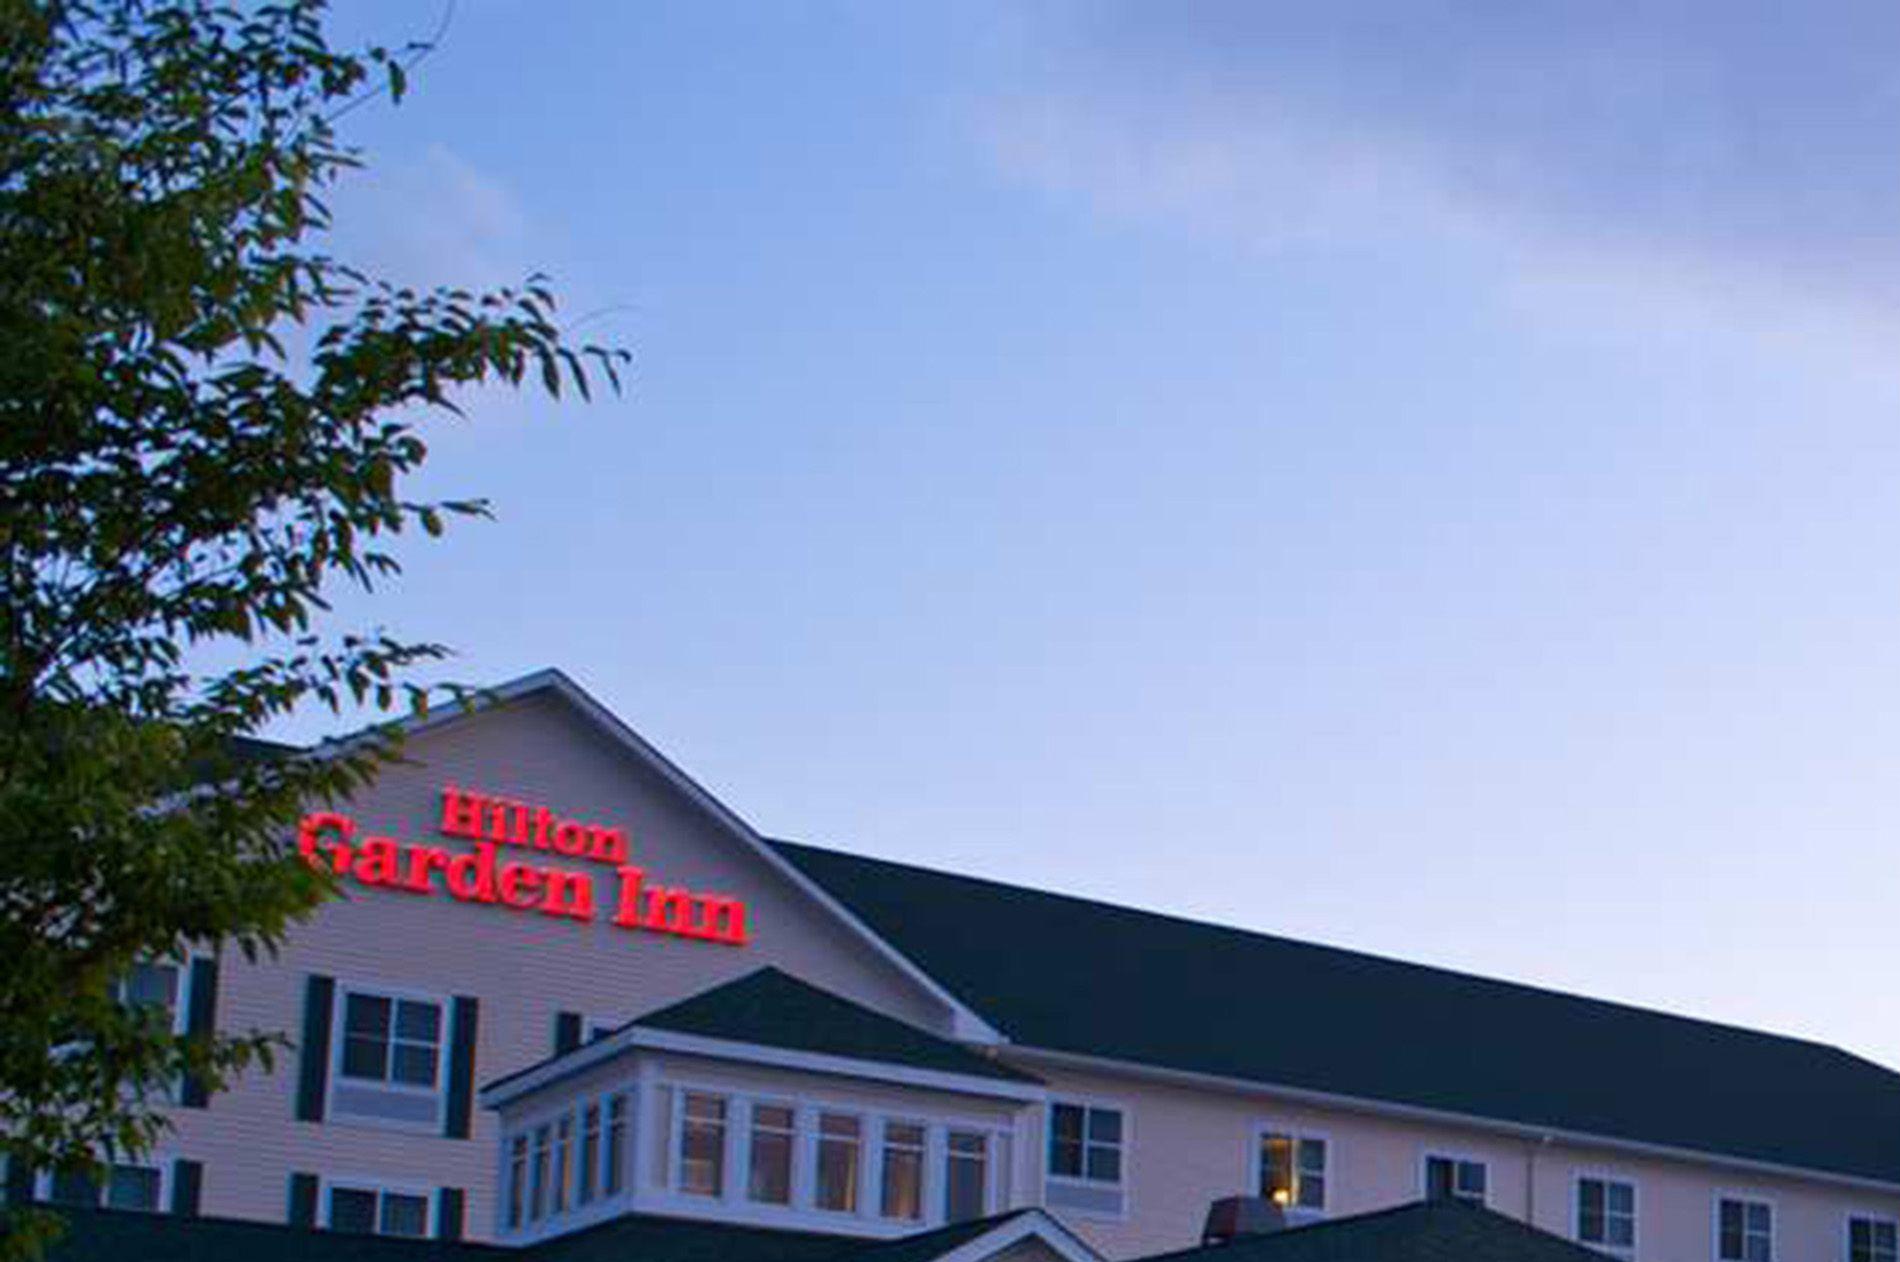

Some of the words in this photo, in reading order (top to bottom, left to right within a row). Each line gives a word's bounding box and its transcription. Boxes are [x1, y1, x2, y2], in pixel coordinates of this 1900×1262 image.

[440, 785, 628, 863] Hilton
[299, 812, 593, 920] Garden
[612, 866, 747, 944] Inn
